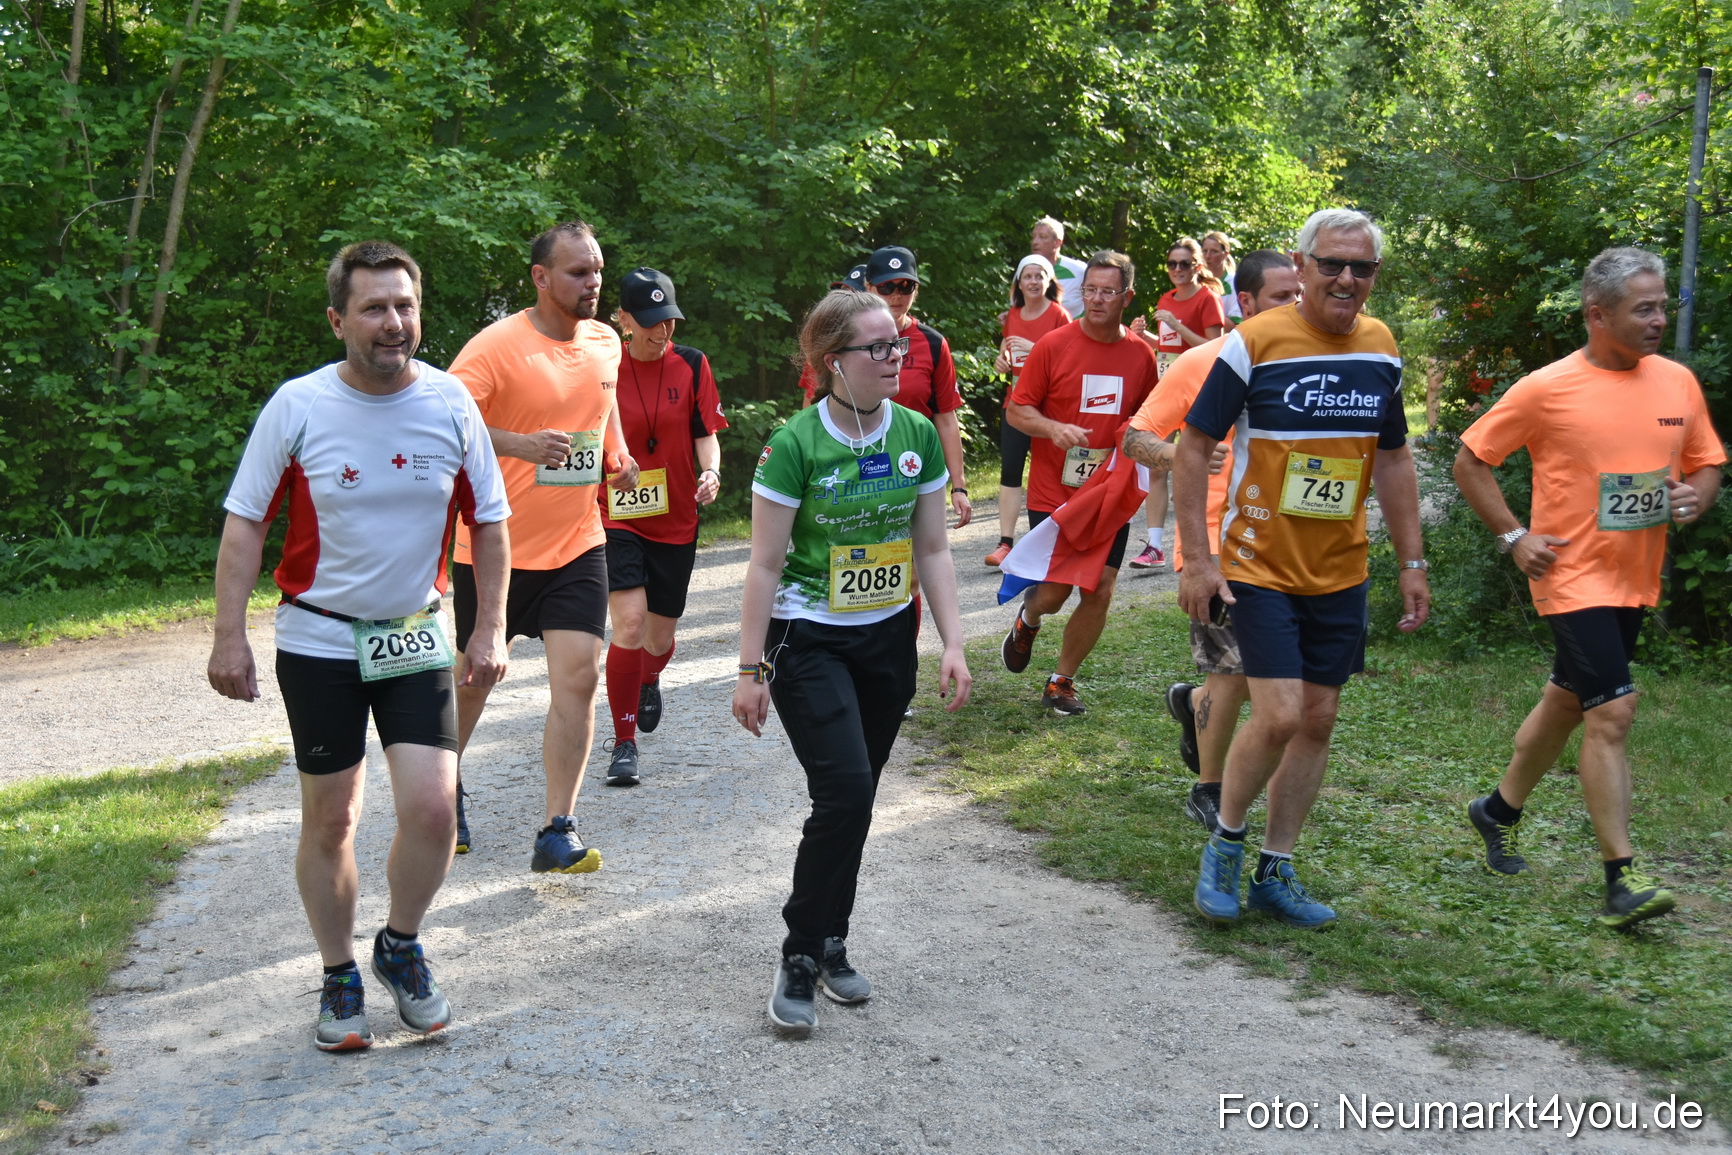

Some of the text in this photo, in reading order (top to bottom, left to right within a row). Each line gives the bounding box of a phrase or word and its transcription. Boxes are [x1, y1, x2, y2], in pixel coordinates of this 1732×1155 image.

[1304, 389, 1380, 407] Fischer
[1312, 409, 1378, 417] AUTOMOBILE
[1657, 417, 1684, 427] THULE
[1075, 462, 1103, 478] 47
[615, 486, 659, 506] 2361
[844, 492, 882, 503] neumarkt
[1302, 477, 1345, 503] 743
[1301, 500, 1324, 508] Fischer
[1607, 489, 1664, 515] 2292
[815, 508, 871, 525] Gesunde
[840, 519, 878, 534] laufen
[840, 564, 901, 594] 2088
[368, 630, 436, 661] 2089
[373, 651, 441, 668] Zimmermann Klaus
